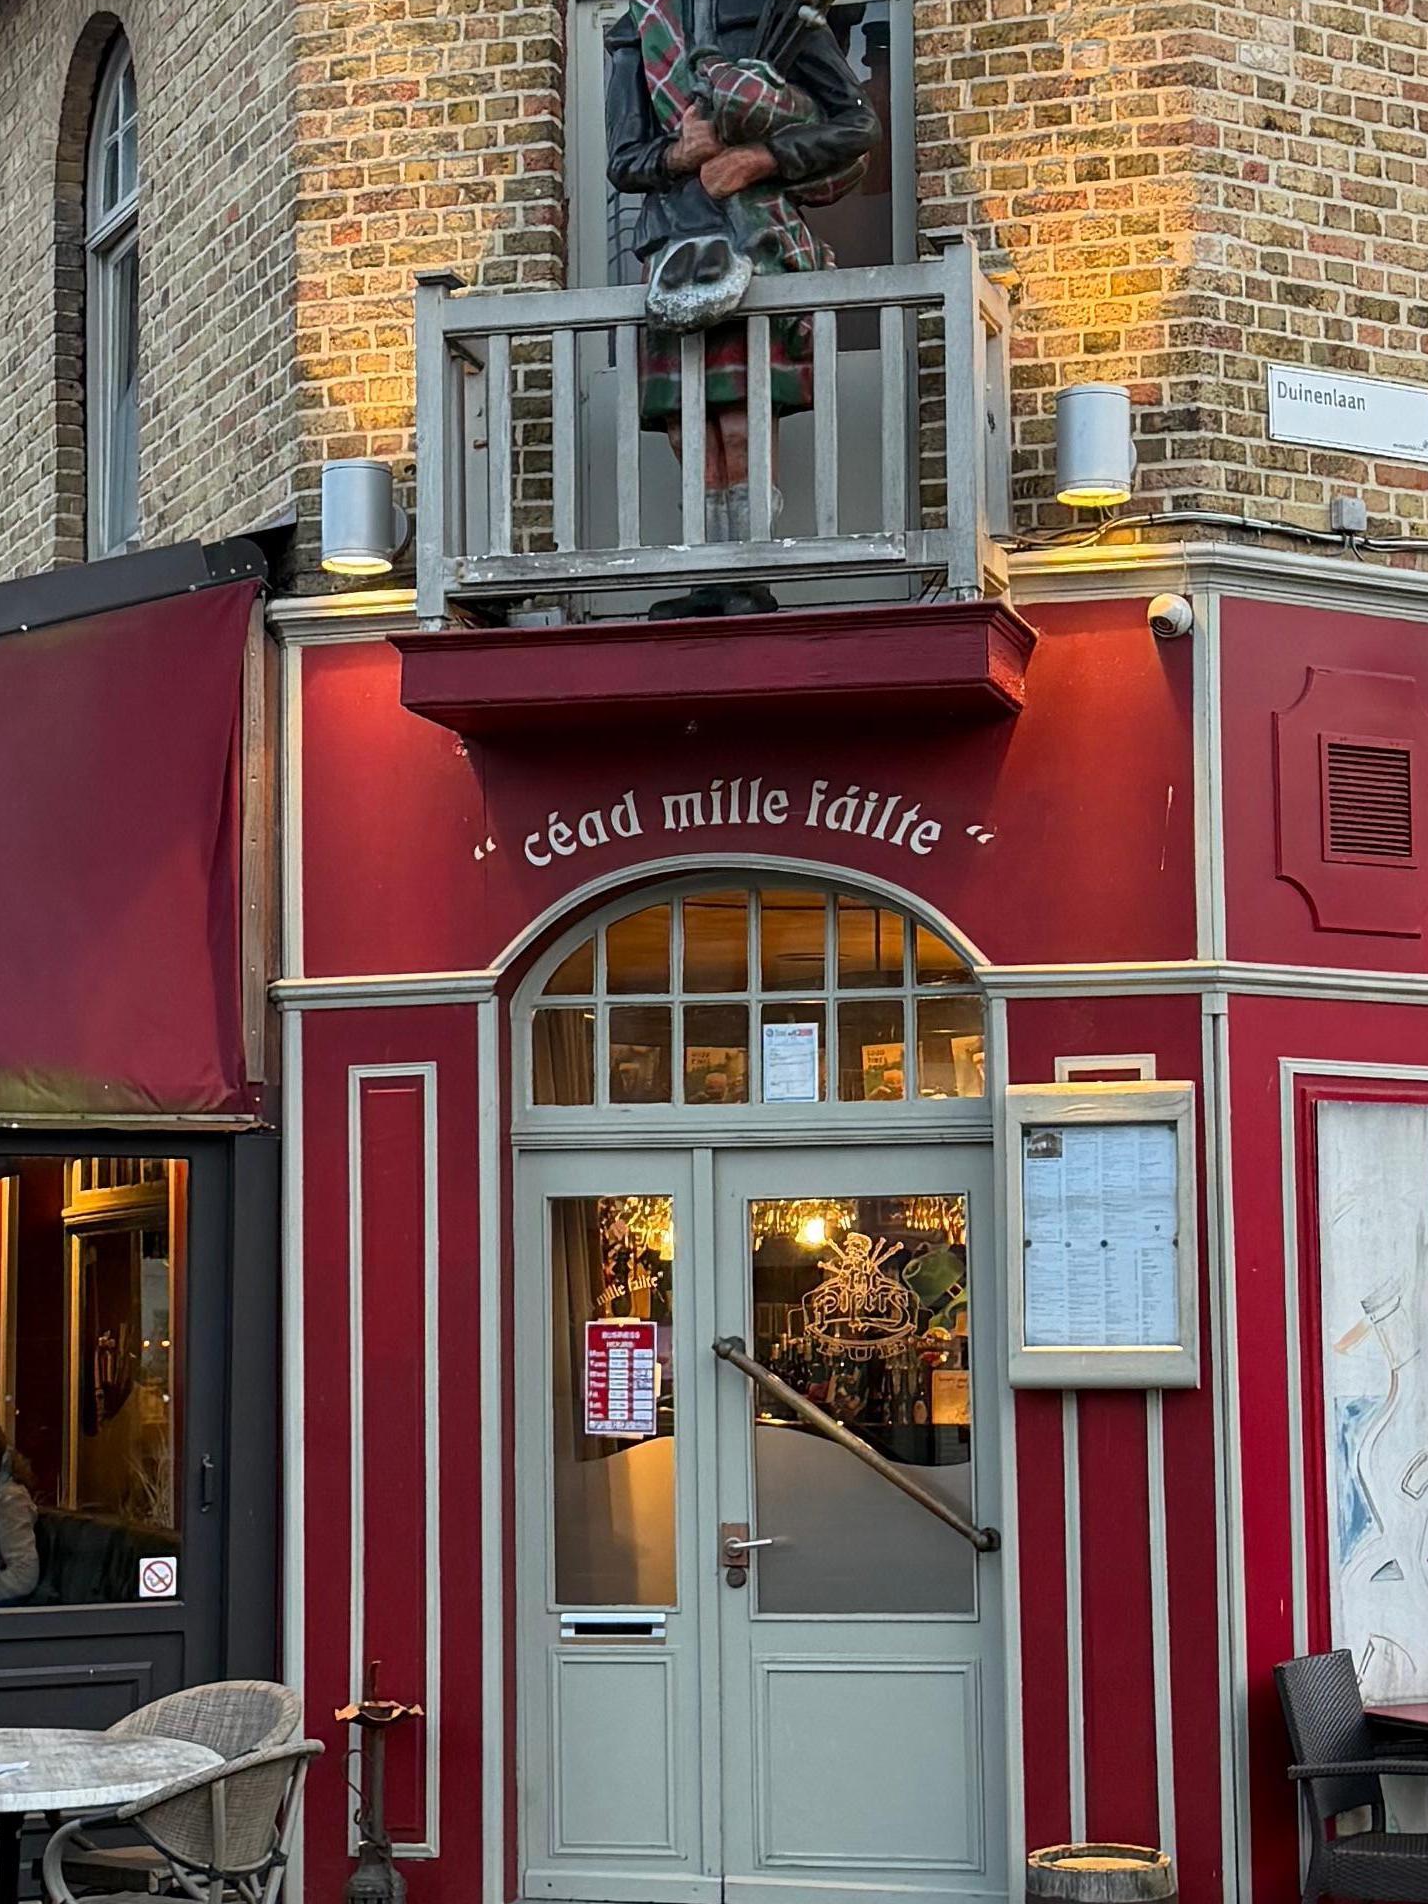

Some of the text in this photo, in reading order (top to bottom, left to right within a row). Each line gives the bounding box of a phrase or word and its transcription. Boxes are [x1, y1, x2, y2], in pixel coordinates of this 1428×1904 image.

[1277, 381, 1366, 411] Duinenlaan
[524, 790, 644, 867] céad
[804, 779, 942, 855] fáilte
